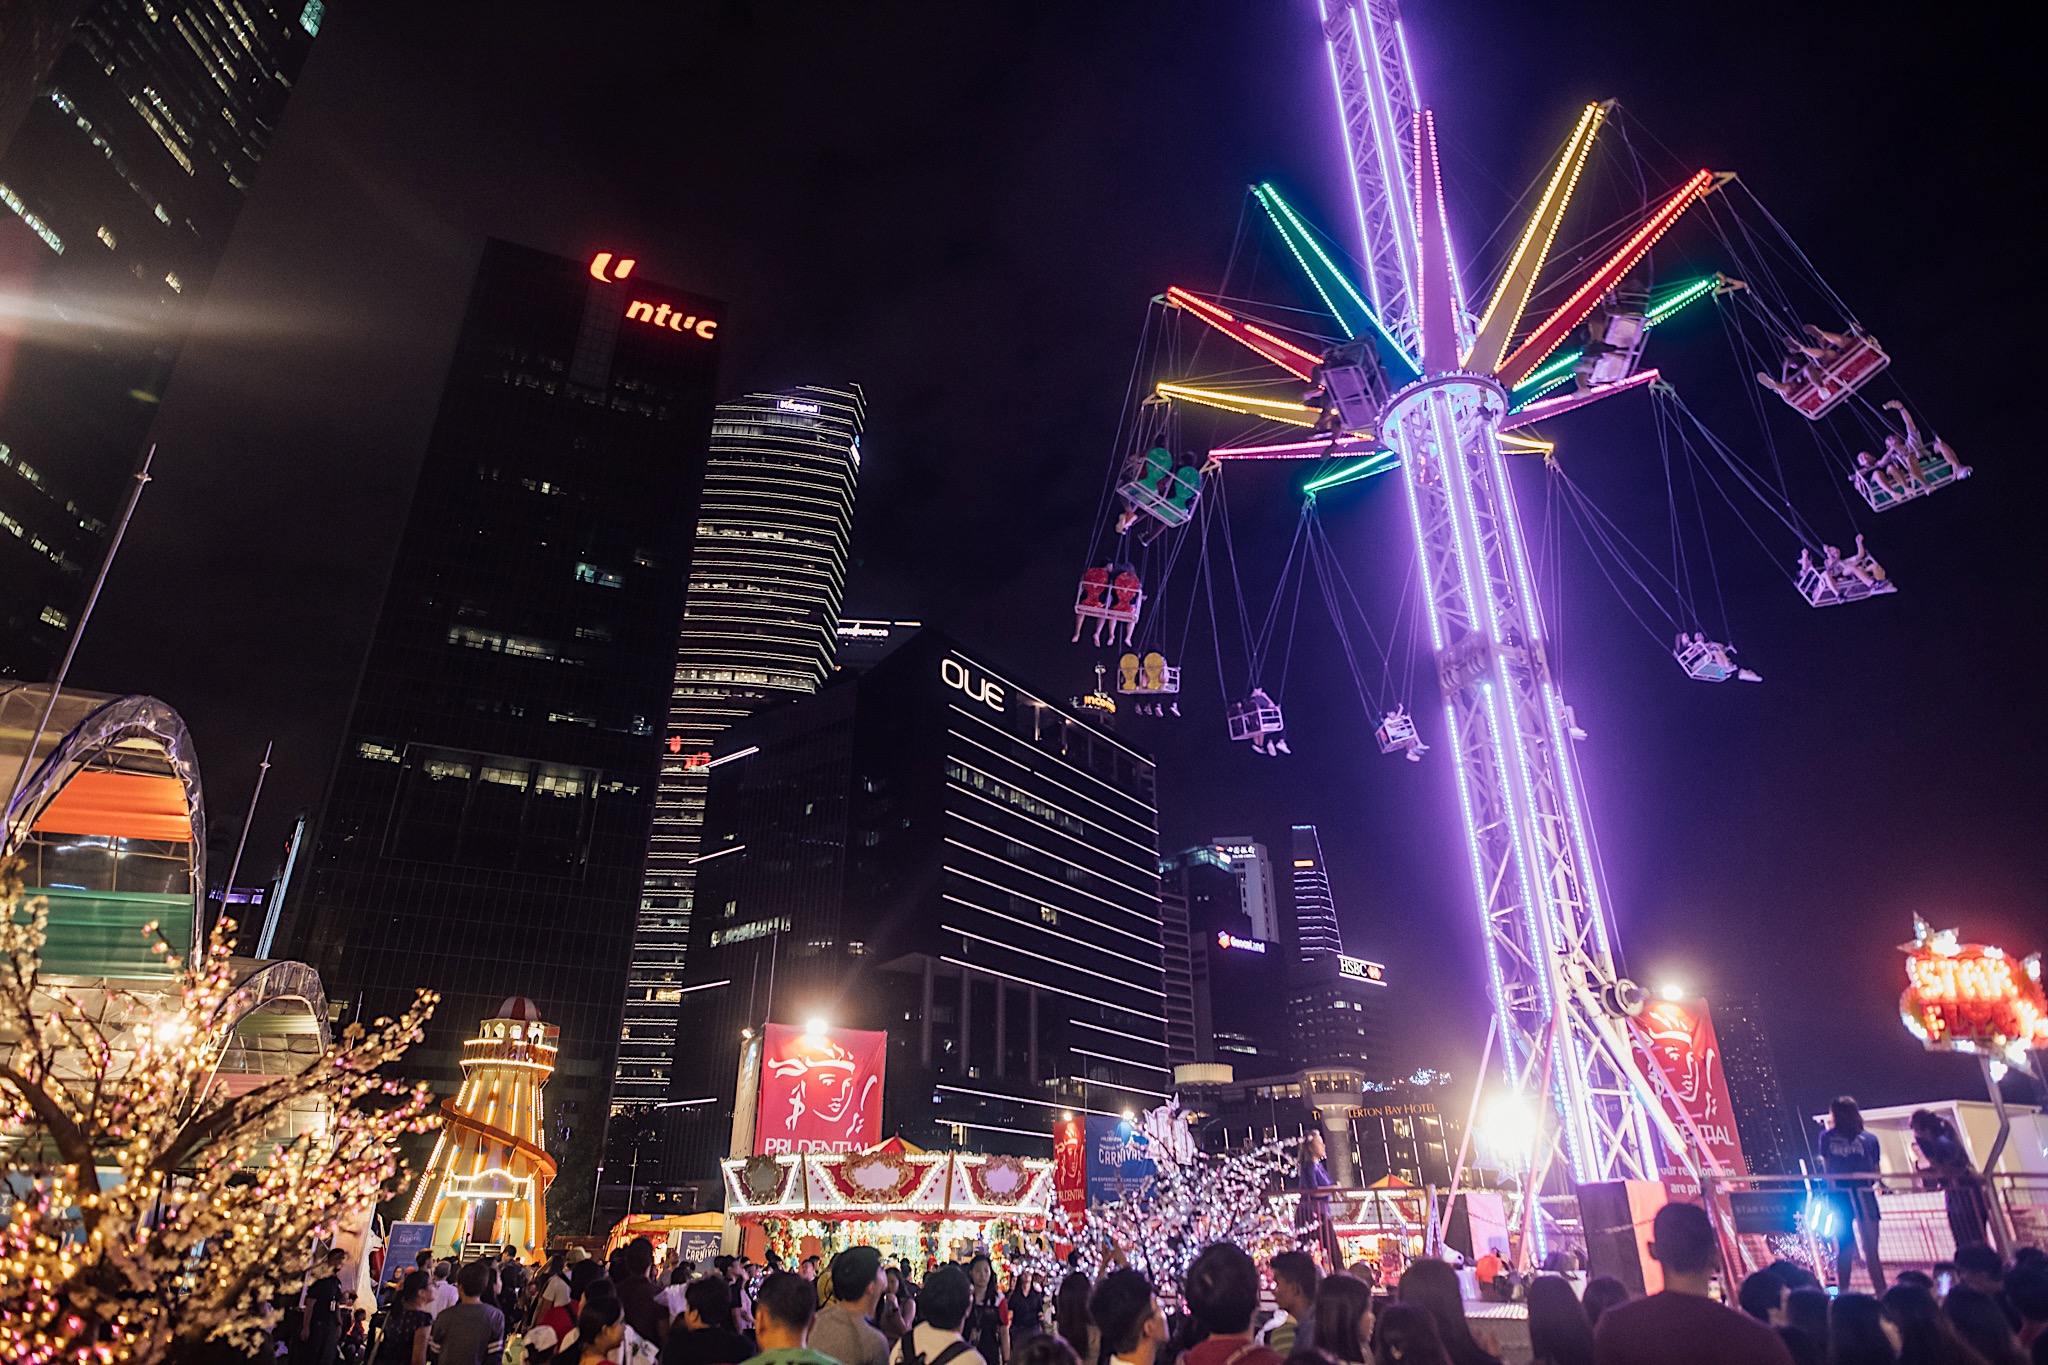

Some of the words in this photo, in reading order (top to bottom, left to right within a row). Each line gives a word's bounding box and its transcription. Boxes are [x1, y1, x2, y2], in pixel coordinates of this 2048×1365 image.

[625, 300, 718, 340] ntuc
[941, 658, 1005, 712] OUE
[1340, 958, 1368, 978] HSBC
[1916, 957, 2019, 1001] STAR
[1348, 1108, 1382, 1119] LERTON
[1384, 1104, 1401, 1116] BAY
[1404, 1103, 1437, 1114] HOTEL
[1099, 1148, 1142, 1167] CARNIVAL
